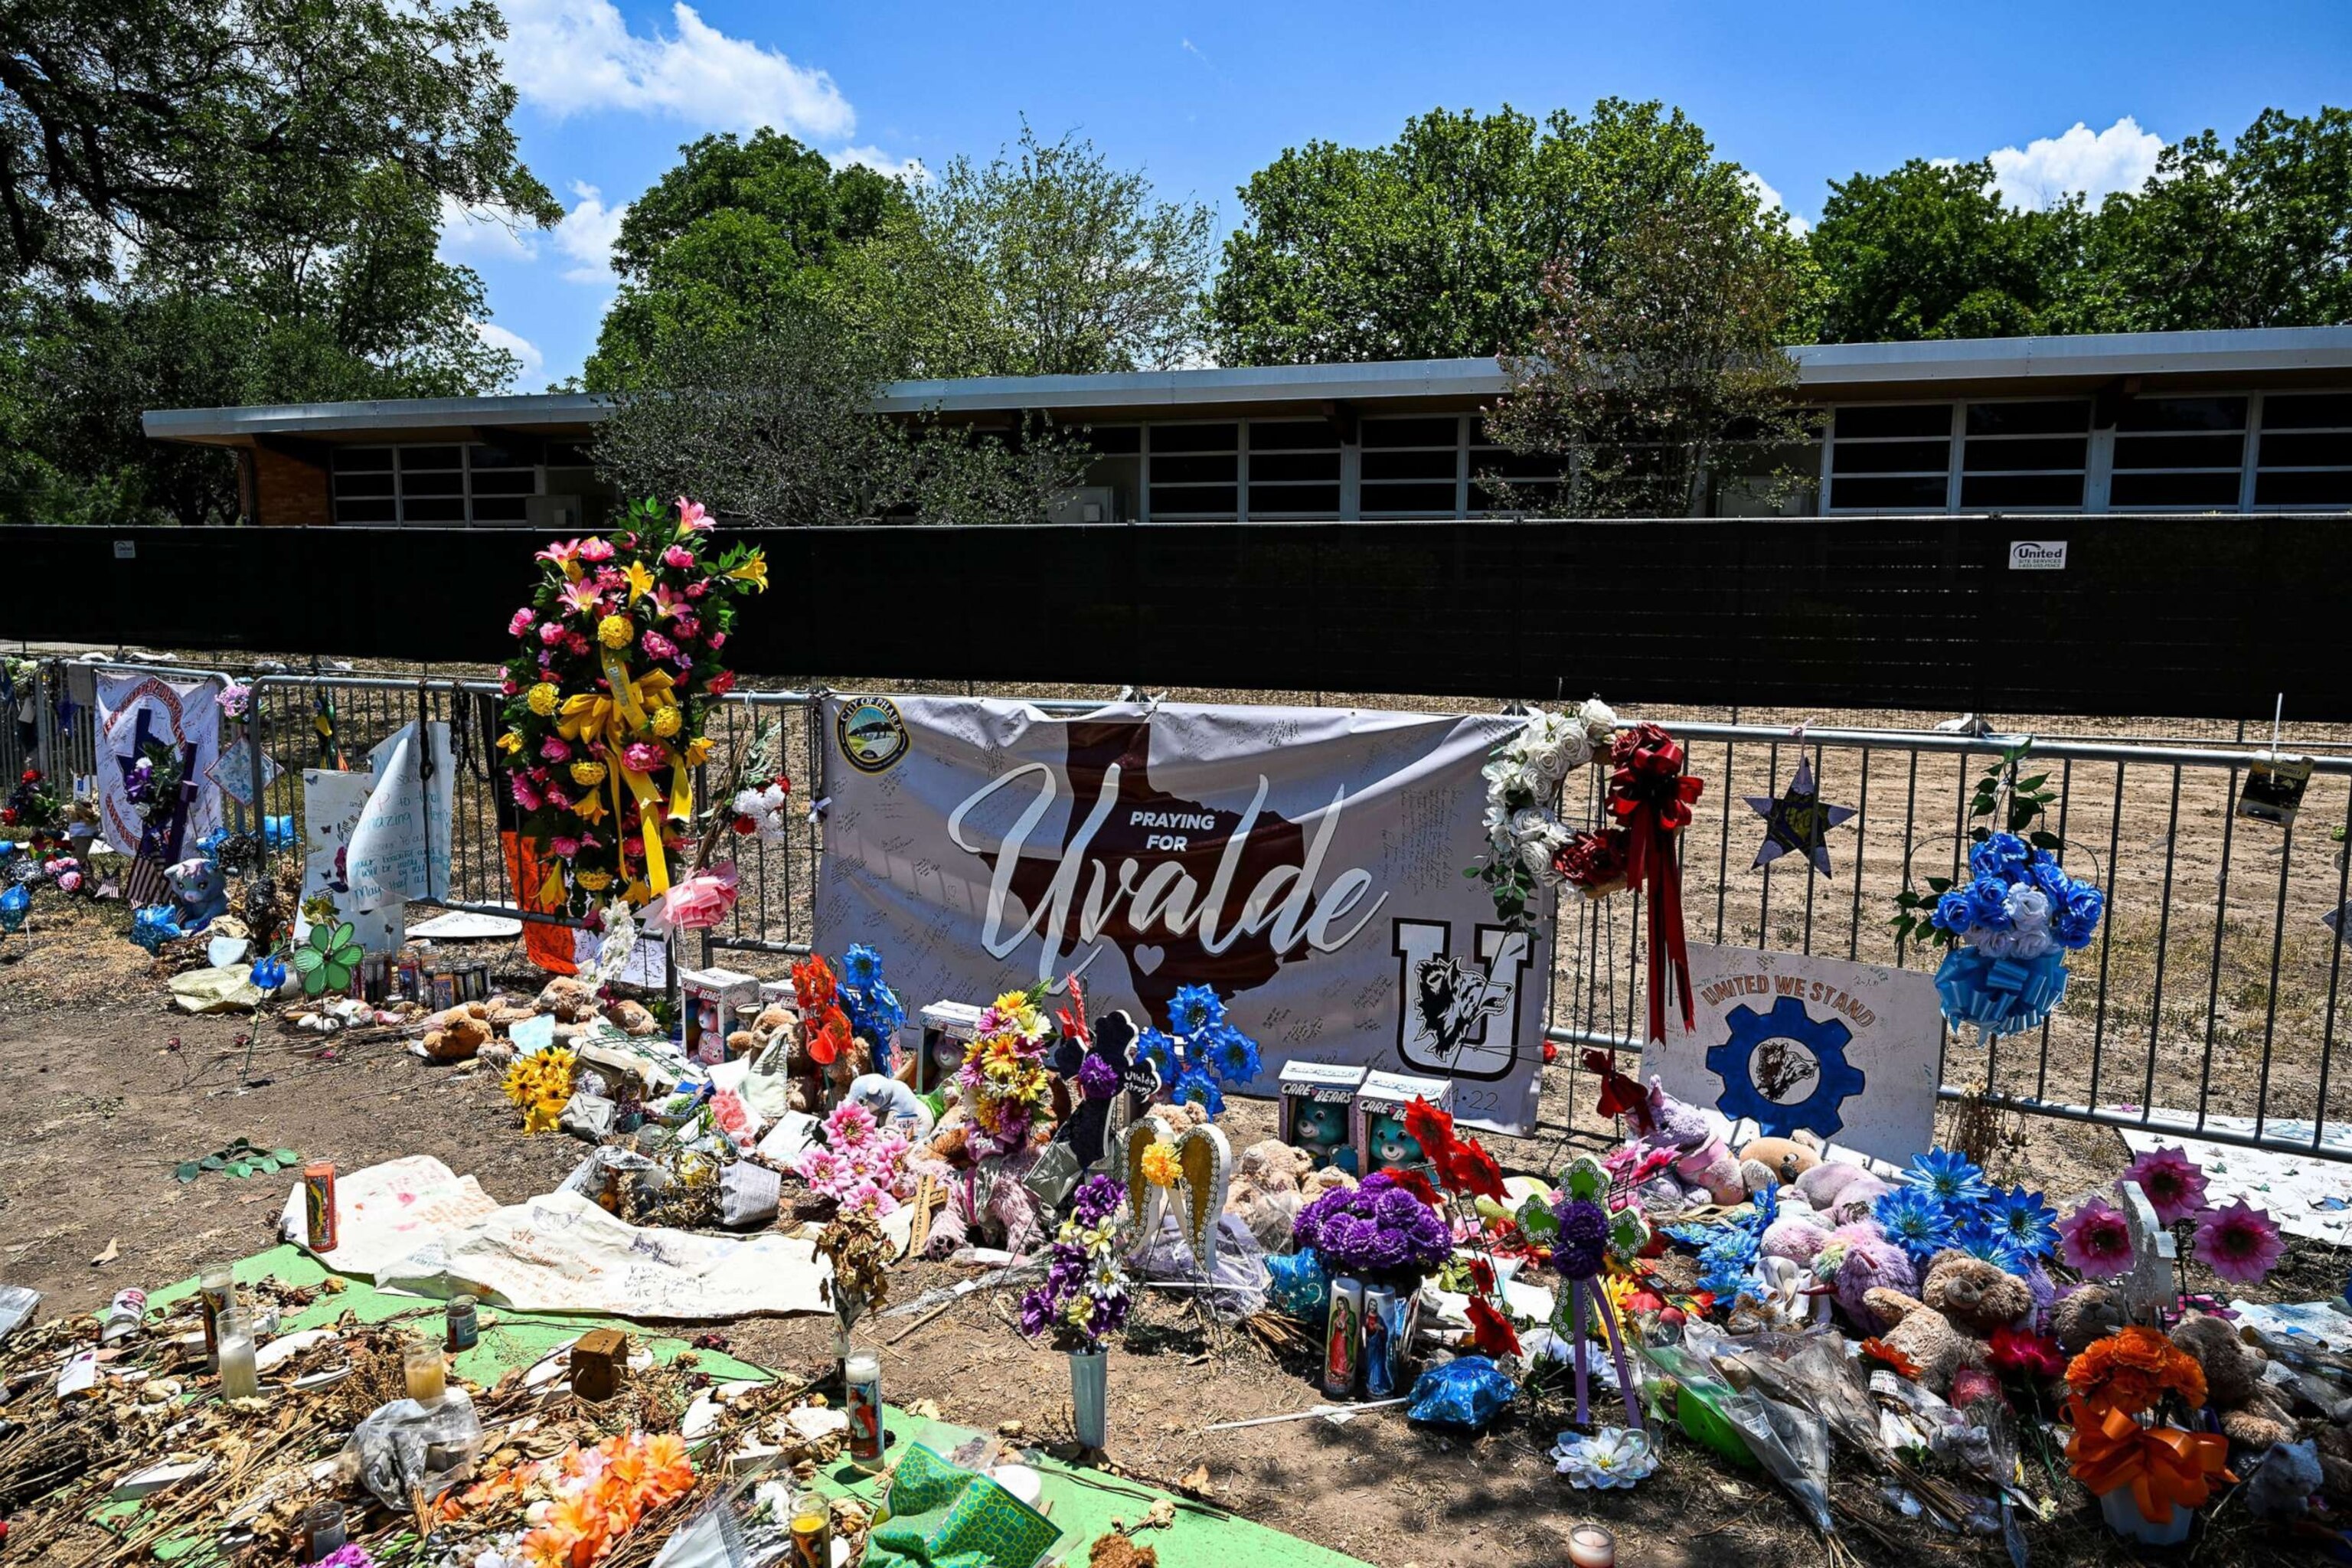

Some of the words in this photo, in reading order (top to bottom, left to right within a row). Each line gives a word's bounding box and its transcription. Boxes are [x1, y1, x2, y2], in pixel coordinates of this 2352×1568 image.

[2019, 548, 2062, 558] United
[841, 700, 858, 721] CITY
[1130, 812, 1215, 830] PRAYING
[1146, 835, 1187, 852] FOR
[948, 763, 1388, 995] Uvalde
[1701, 975, 1769, 1007] UNITED
[1775, 975, 1807, 997] WE
[1809, 982, 1876, 1027] STAND
[1281, 1082, 1315, 1096] CARE
[1314, 1089, 1354, 1104] BEARS
[1358, 1099, 1393, 1114] CARE
